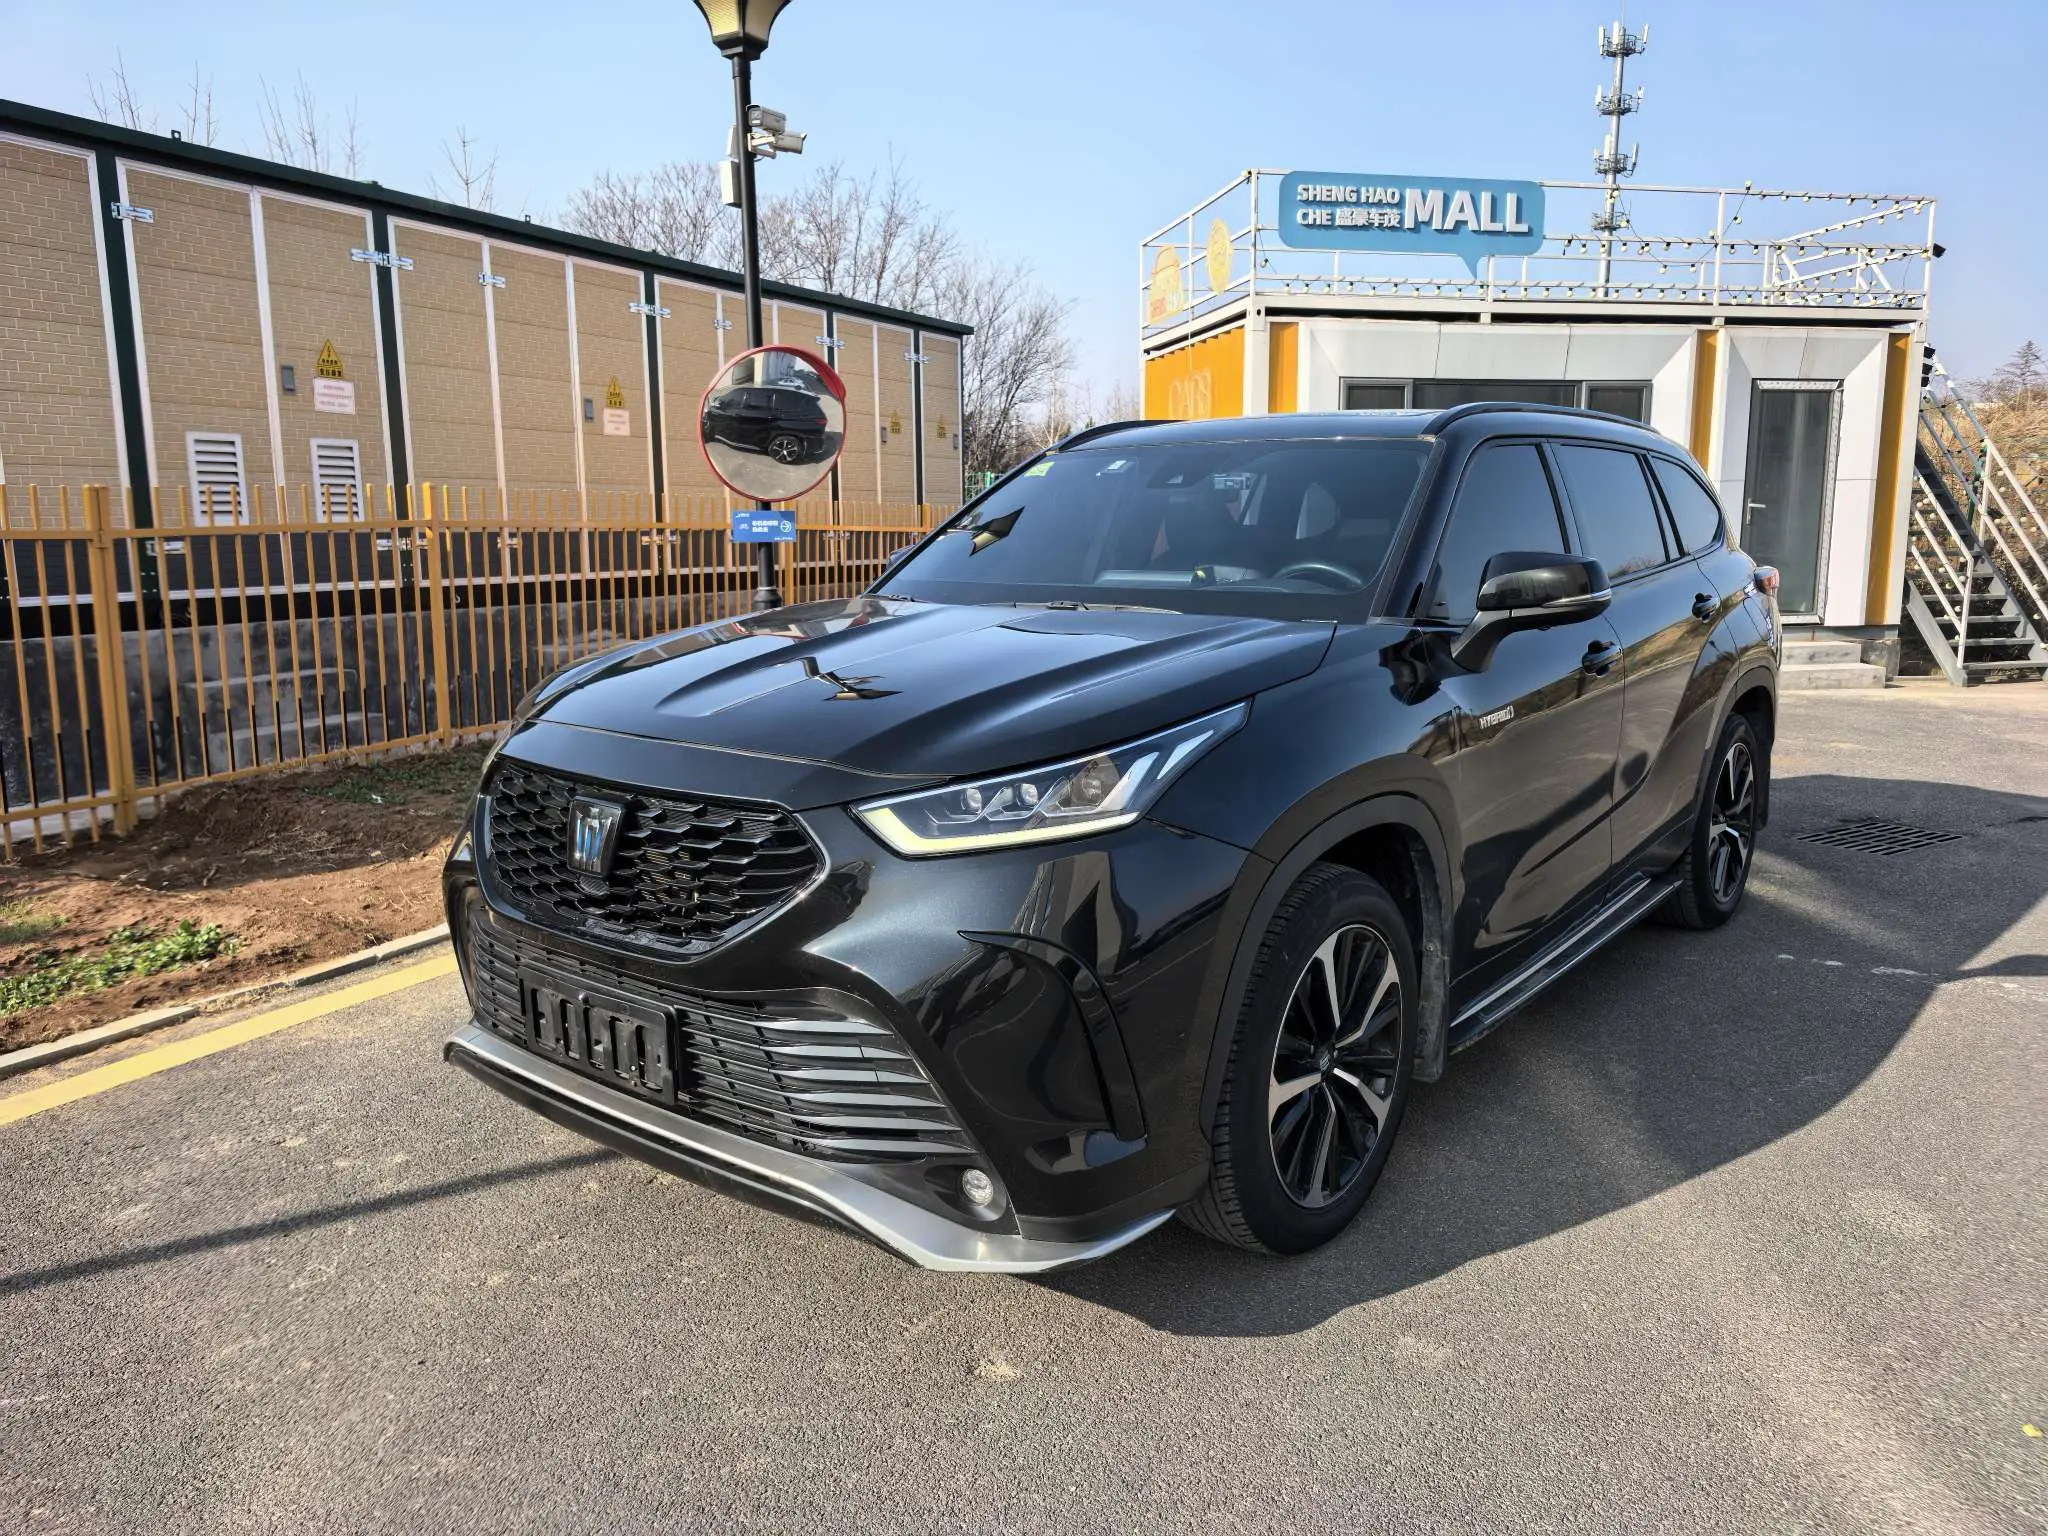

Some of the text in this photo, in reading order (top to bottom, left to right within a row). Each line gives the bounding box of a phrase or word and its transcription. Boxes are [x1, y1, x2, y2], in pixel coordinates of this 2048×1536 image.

[1297, 184, 1400, 204] SHENG HAO
[1296, 208, 1332, 226] CHE
[1404, 188, 1529, 233] MALL
